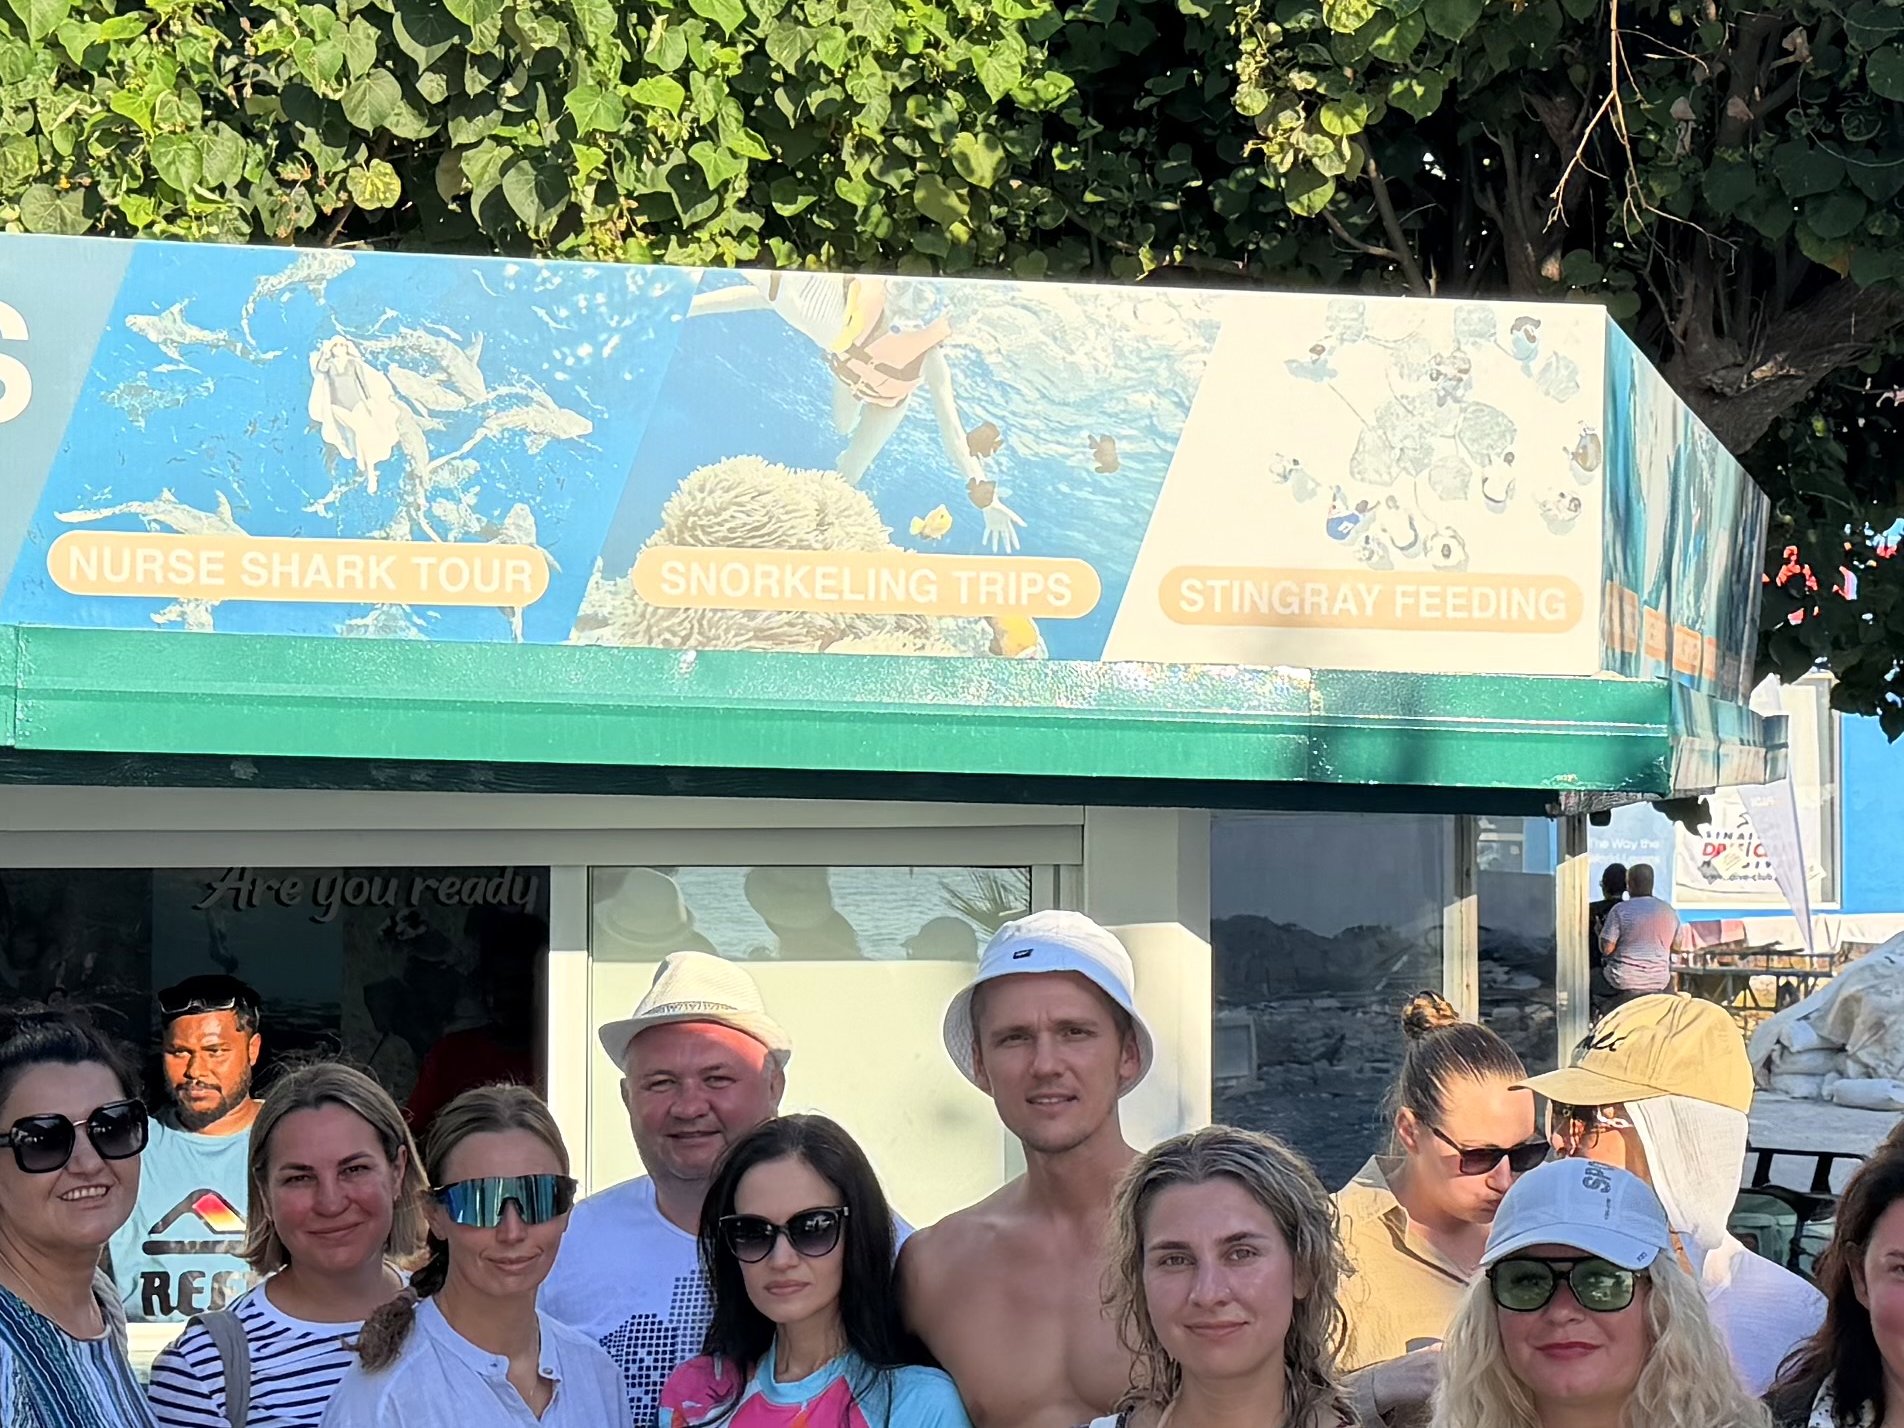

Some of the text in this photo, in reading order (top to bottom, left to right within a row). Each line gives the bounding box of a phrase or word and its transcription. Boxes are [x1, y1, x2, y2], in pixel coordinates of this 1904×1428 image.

[67, 544, 534, 594] NURSE SHARK TOUR
[659, 559, 1074, 608] SNORKELING TRIPS
[1179, 578, 1568, 621] STINGRAY FEEDING
[192, 866, 539, 924] Are you ready
